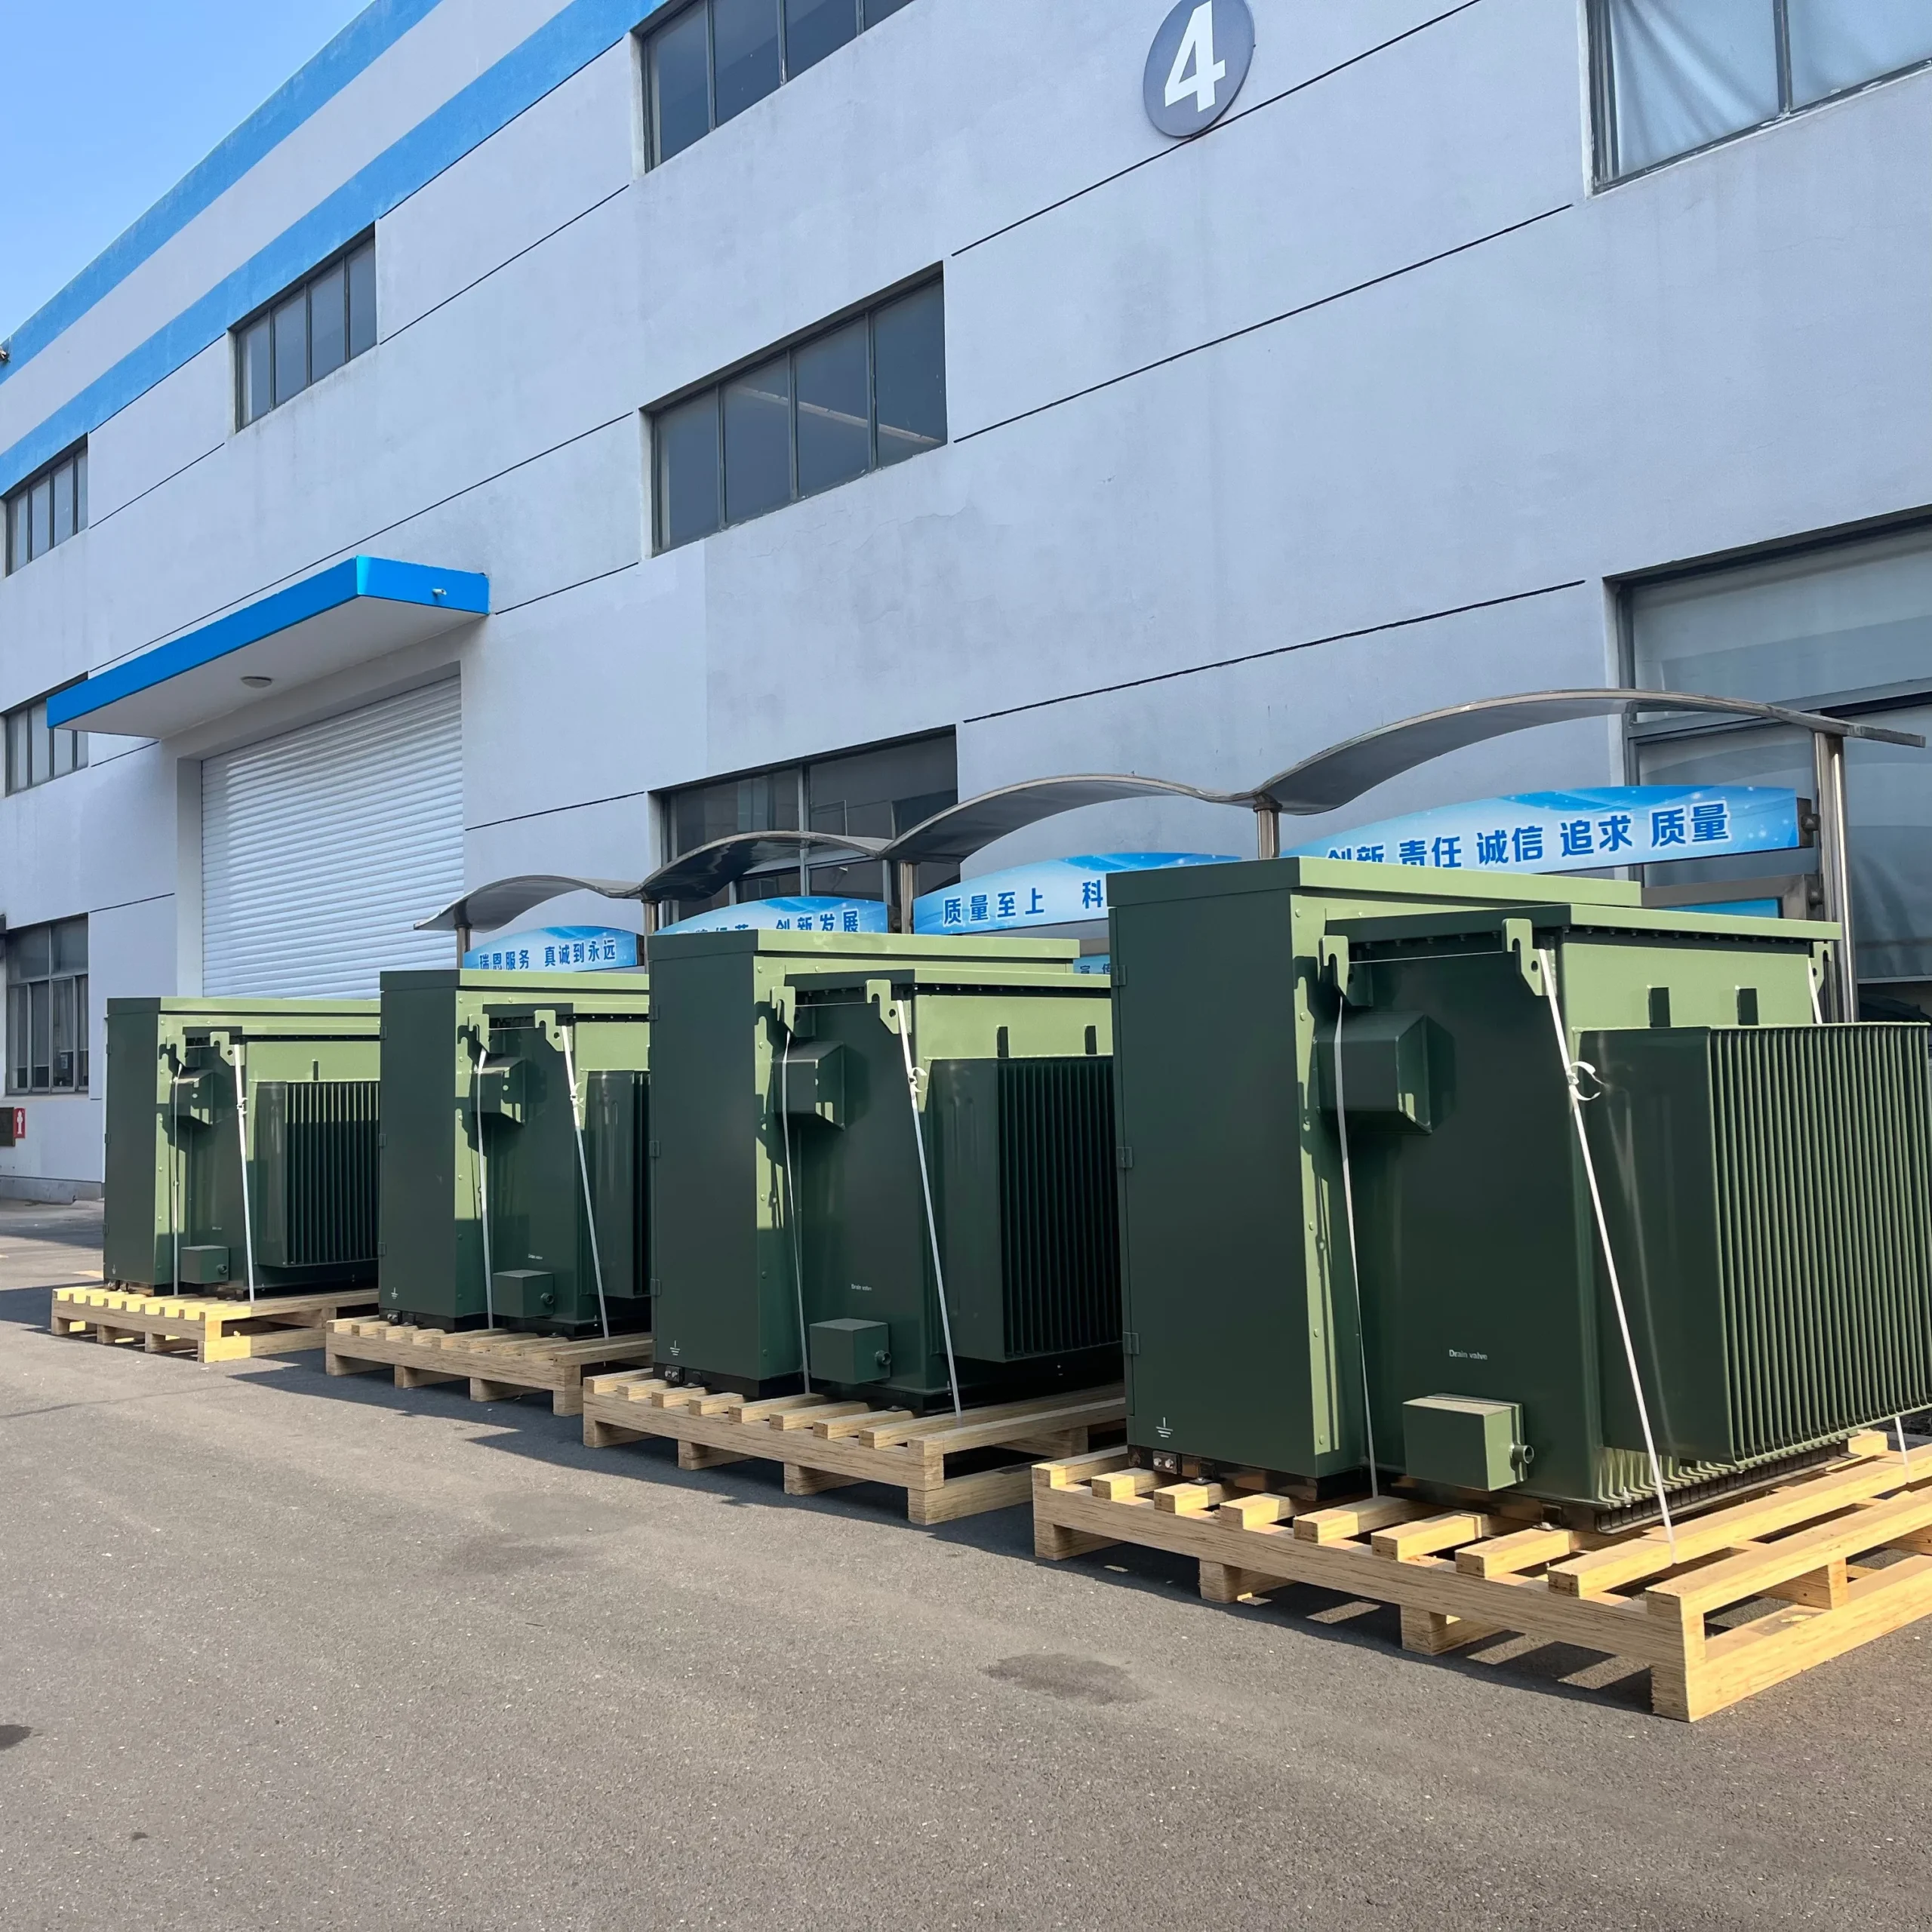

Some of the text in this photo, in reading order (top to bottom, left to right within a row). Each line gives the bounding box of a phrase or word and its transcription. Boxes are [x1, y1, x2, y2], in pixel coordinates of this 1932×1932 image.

[1164, 0, 1226, 112] 4
[1399, 836, 1462, 868] 责任
[1476, 826, 1543, 865] 诚信
[1560, 813, 1632, 856] 追求
[1651, 804, 1730, 847] 质量
[943, 888, 1045, 925] 质量至上
[544, 940, 615, 967] 真诚到永远
[1449, 1349, 1468, 1358] Drain
